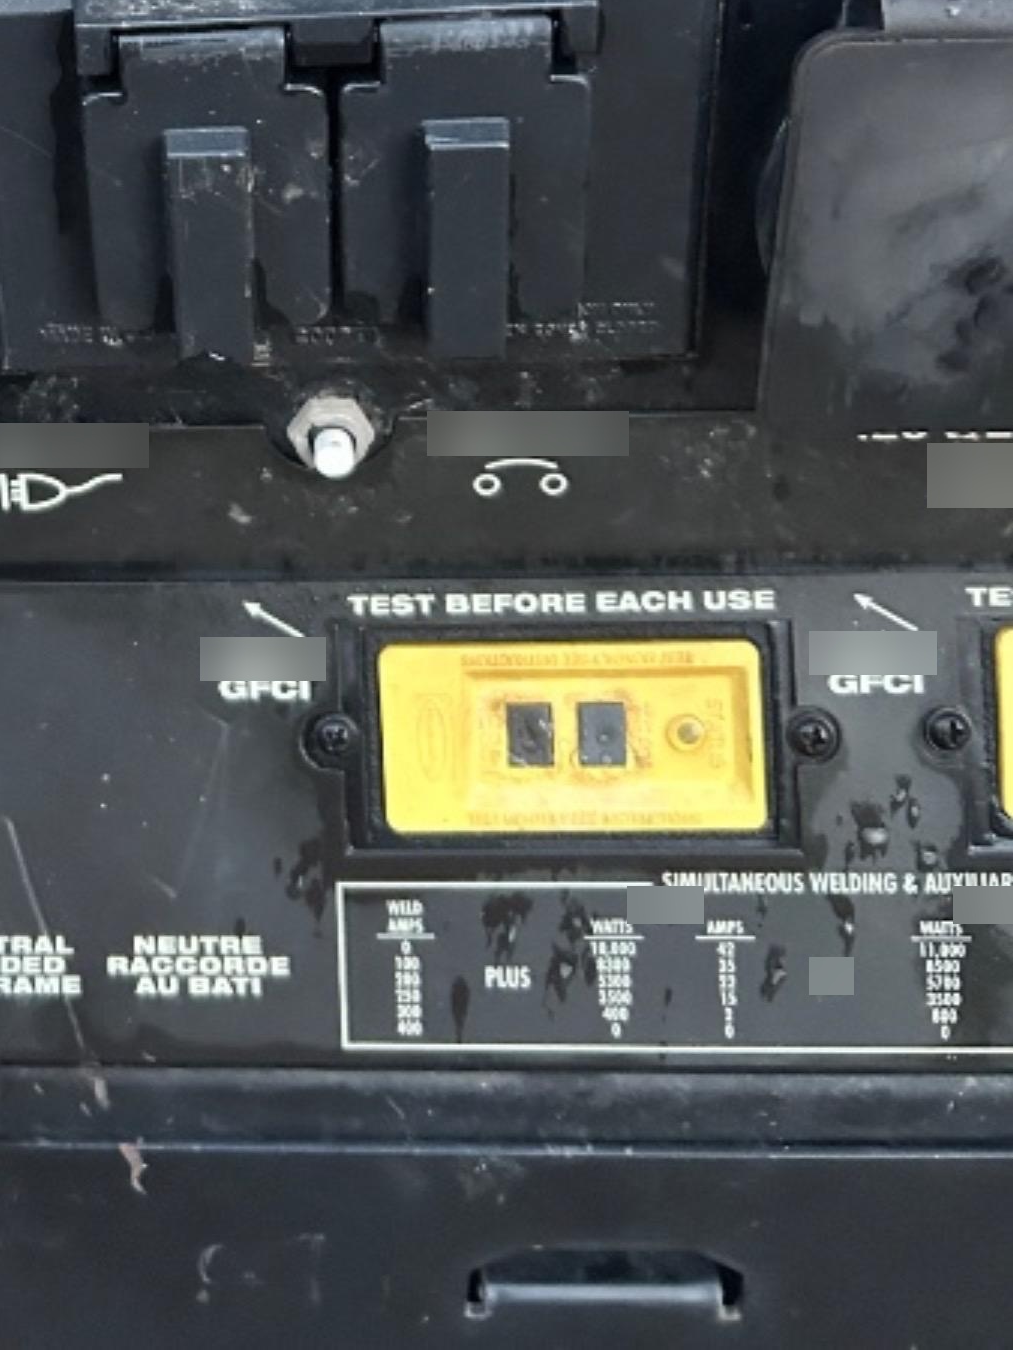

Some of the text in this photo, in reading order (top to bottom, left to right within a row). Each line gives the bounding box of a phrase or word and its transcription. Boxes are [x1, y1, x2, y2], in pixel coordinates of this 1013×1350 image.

[347, 590, 776, 617] TEST BEFORE EACH USE
[218, 680, 312, 701] GFCI
[827, 674, 926, 694] GFCI
[661, 872, 804, 894] SIMULTANEOUS
[809, 872, 898, 894] WELDING
[902, 873, 918, 893] &
[591, 918, 633, 934] WATTS
[706, 920, 744, 934] AMPS
[133, 935, 262, 955] NEUTRE
[107, 956, 290, 976] RACCORDE
[135, 976, 263, 995] AU BATI
[485, 965, 532, 988] PLUS
[611, 1023, 621, 1038] 0
[724, 1023, 734, 1038] 0
